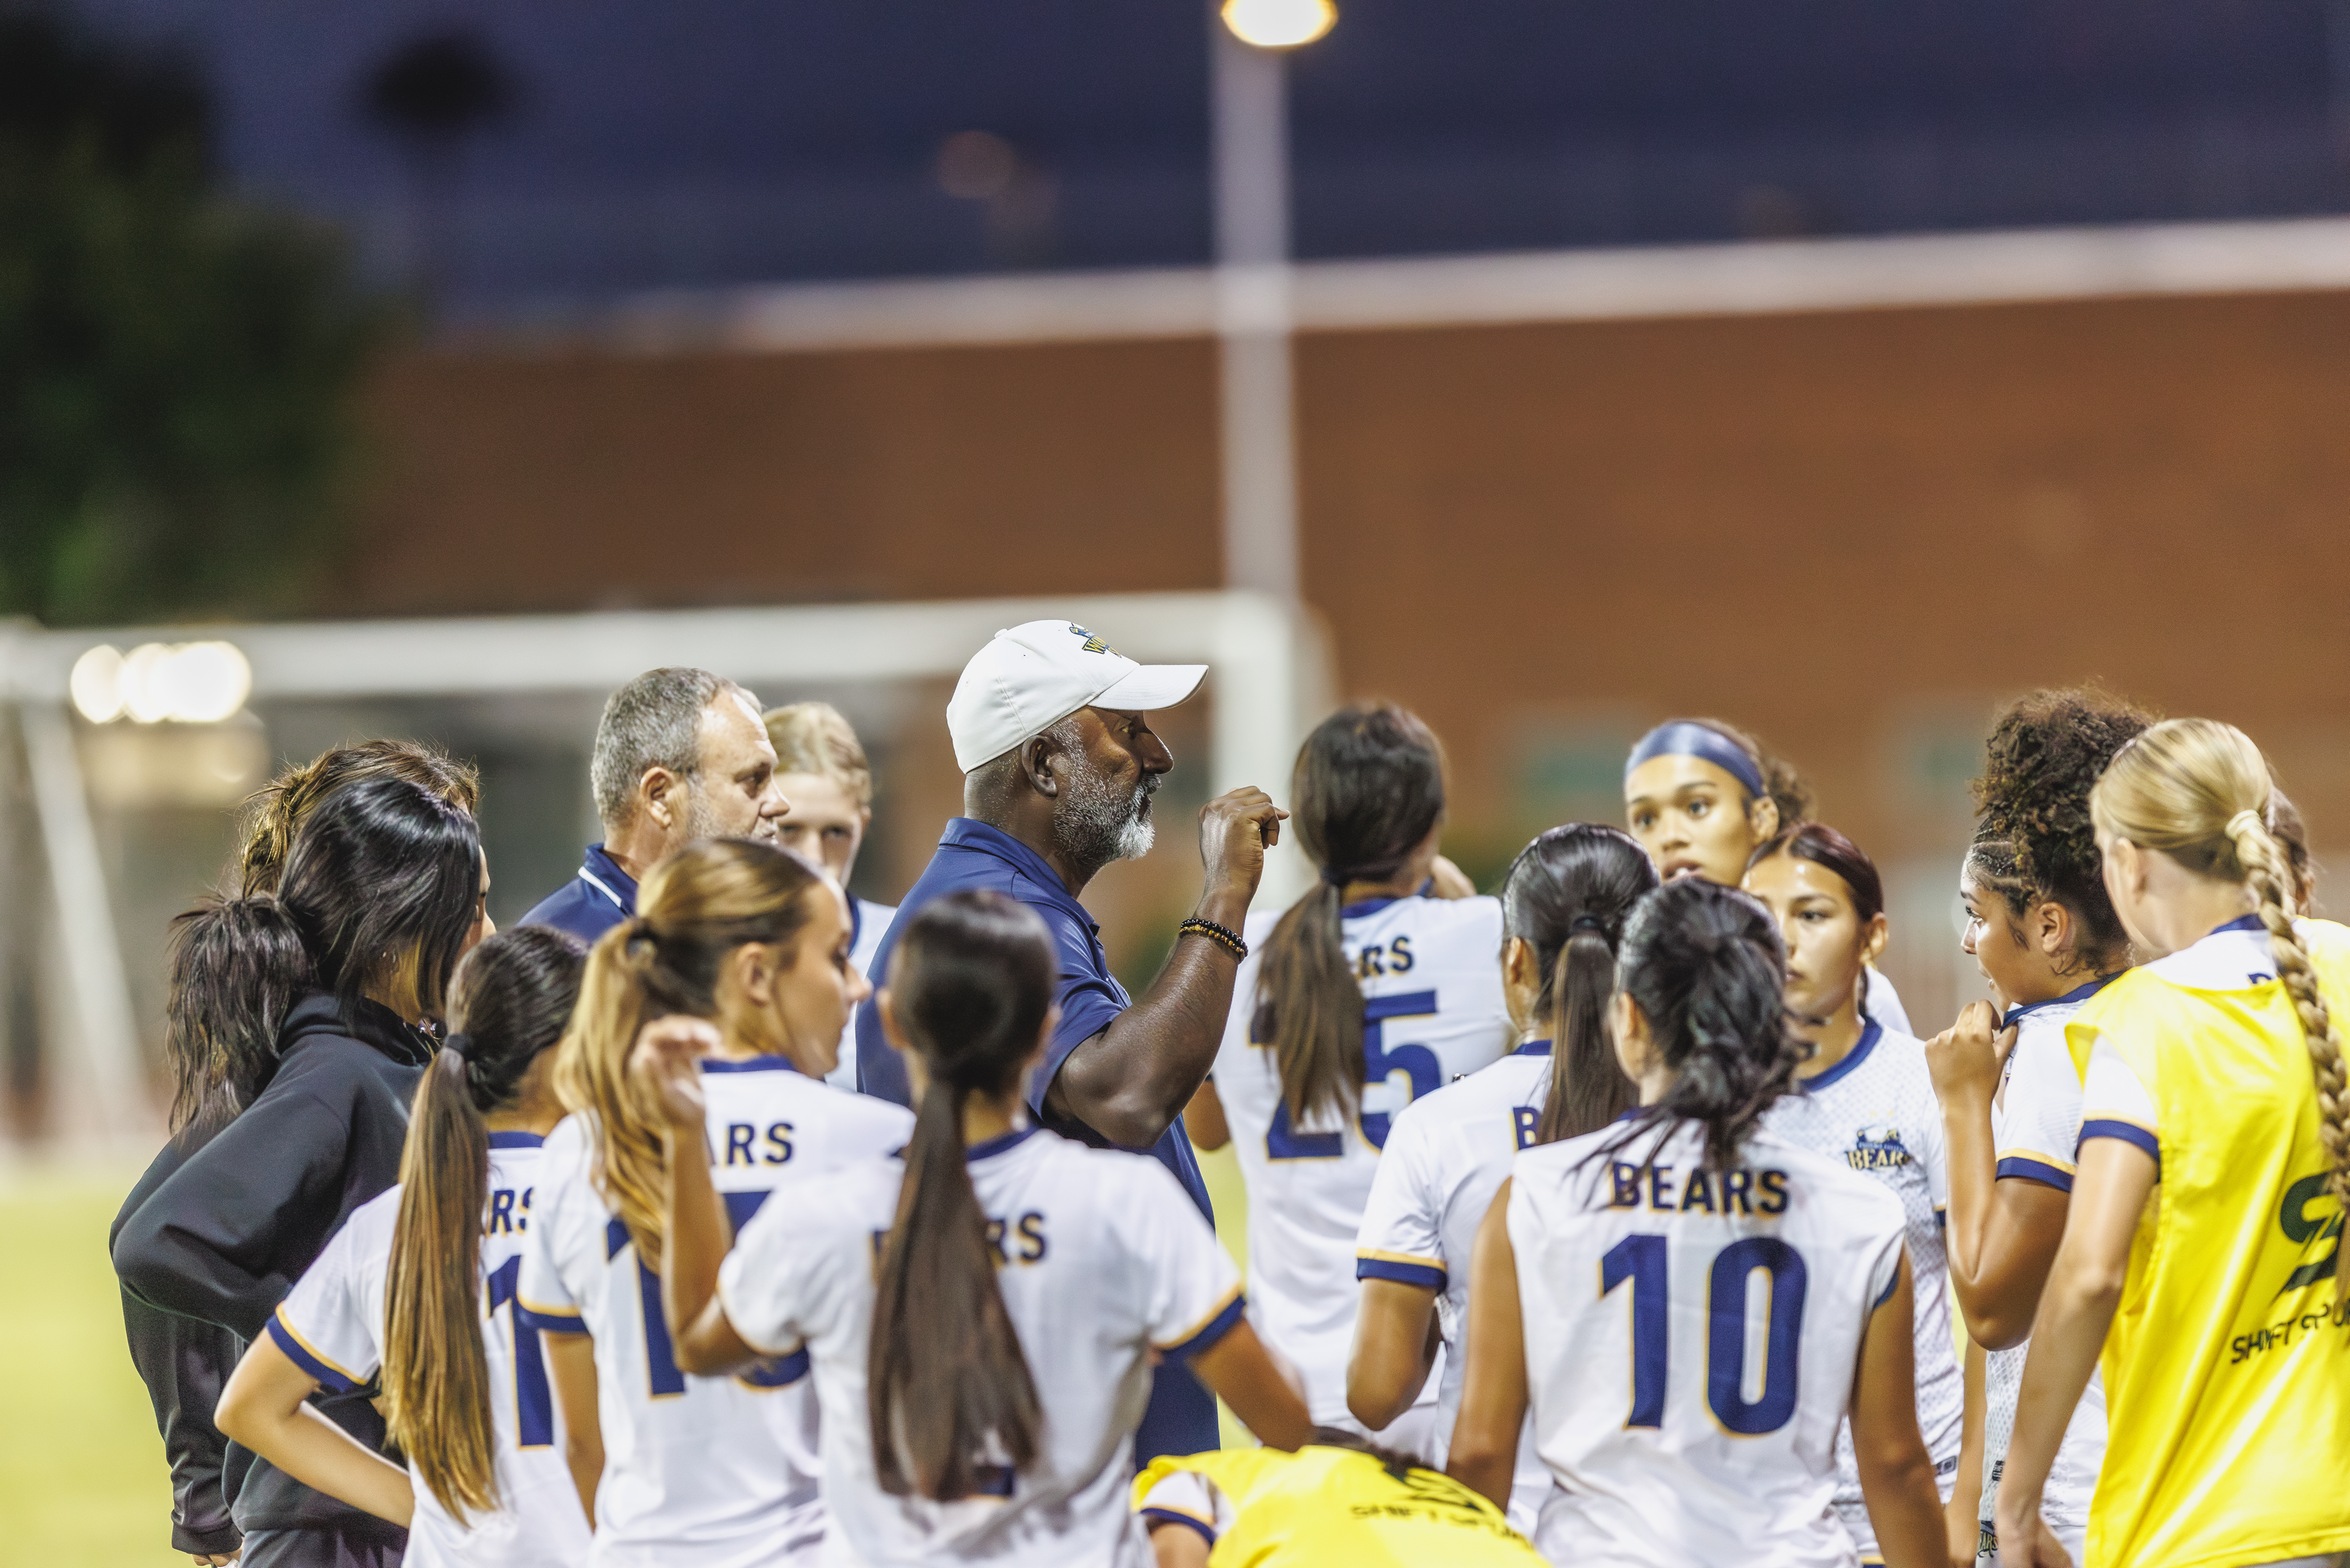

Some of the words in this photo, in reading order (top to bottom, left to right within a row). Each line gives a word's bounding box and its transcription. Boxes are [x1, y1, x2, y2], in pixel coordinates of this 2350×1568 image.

[706, 1121, 796, 1170] RS
[1608, 1162, 1790, 1220] BEARS
[1597, 1234, 1809, 1440] 10
